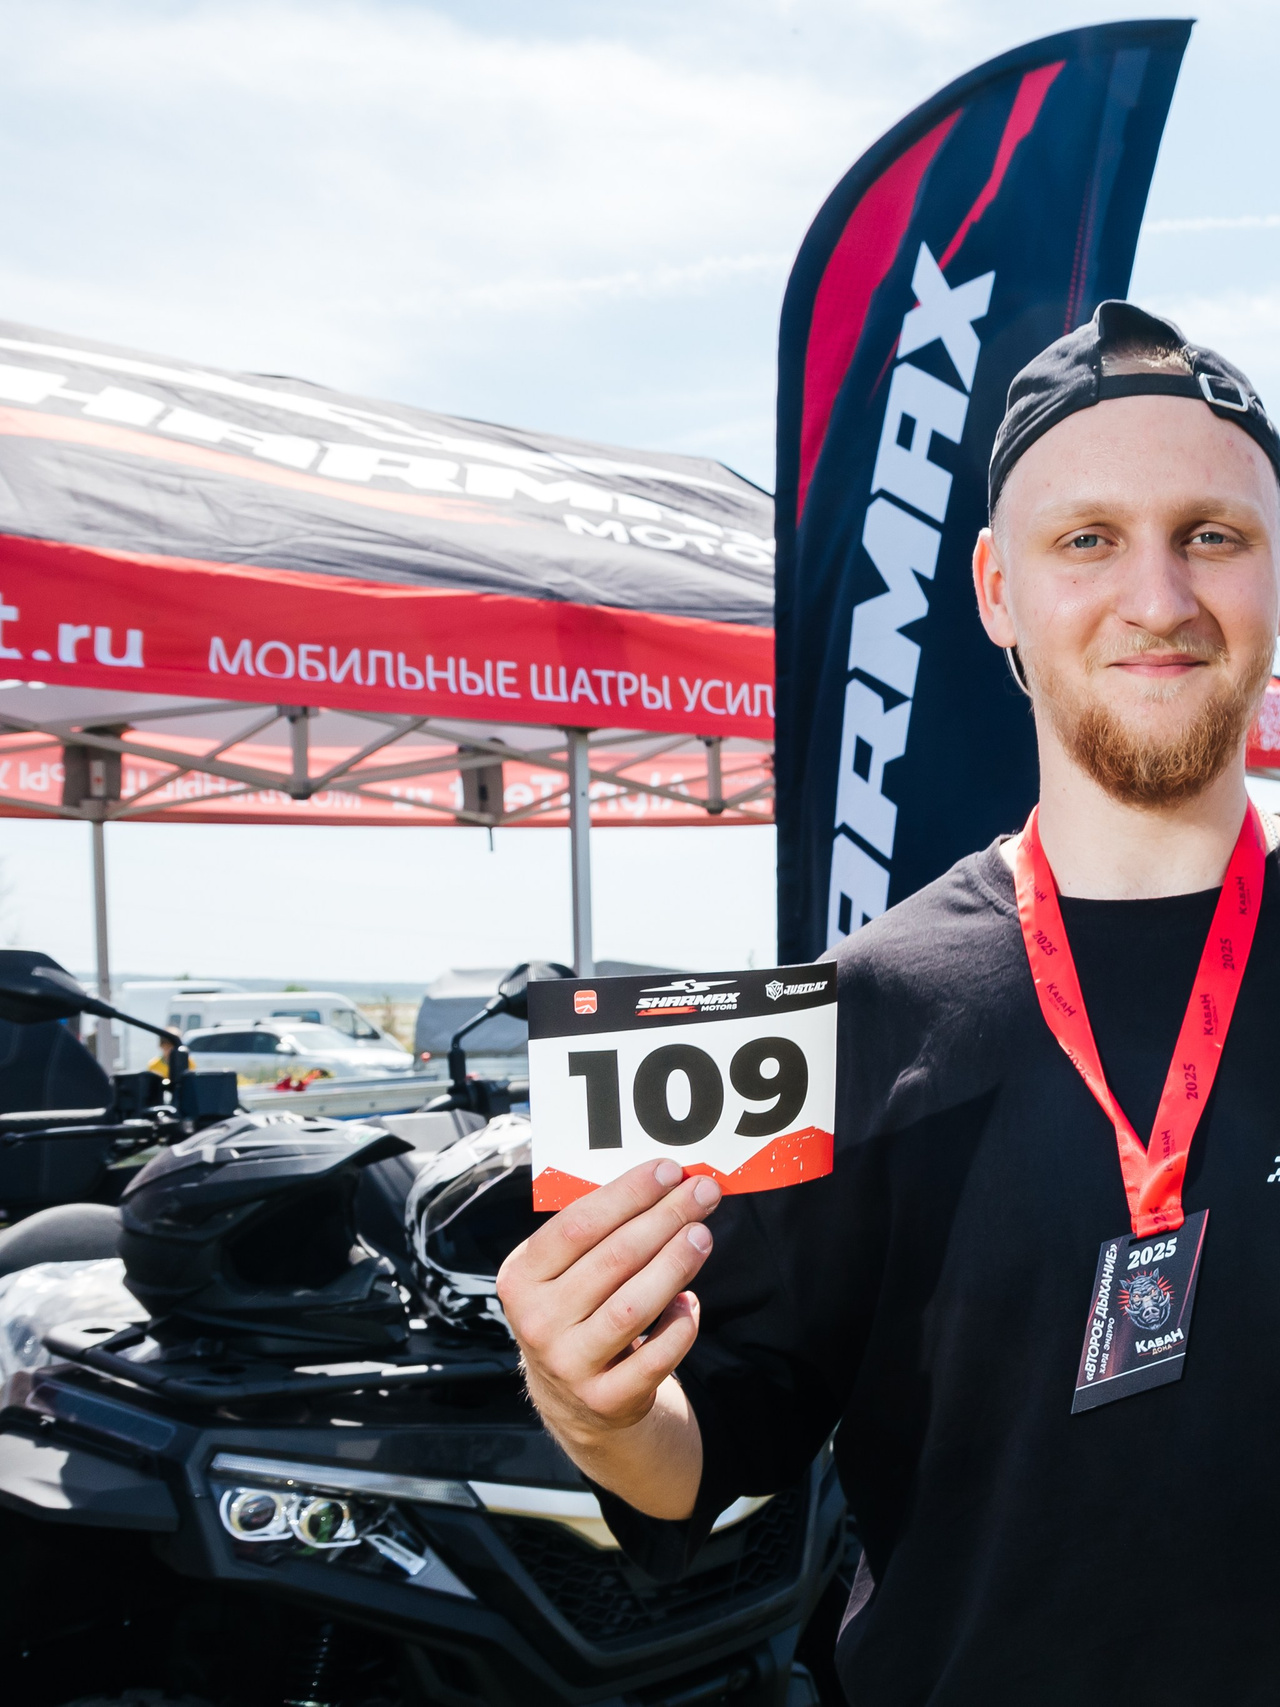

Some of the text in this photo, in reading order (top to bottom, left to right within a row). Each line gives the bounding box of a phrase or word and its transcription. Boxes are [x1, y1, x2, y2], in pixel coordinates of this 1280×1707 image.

[208, 635, 522, 700] МОБИЛЬНЫЕ
[530, 663, 673, 711] ШАТРЫ
[1032, 930, 1058, 956] 2025
[1219, 937, 1235, 971] 2025
[635, 992, 741, 1009] SHARMAX
[701, 1003, 738, 1012] MOTORS
[1046, 982, 1077, 1017] КАБАН
[1200, 993, 1214, 1036] КАБАН
[568, 1036, 809, 1150] 109
[1183, 1063, 1199, 1100] 2025
[1127, 1237, 1178, 1270] 2025
[1085, 1243, 1118, 1382] «ВТОРОЕ ДЫХАНИЕ»
[1099, 1317, 1116, 1374] ХАРД ЭНДУРО
[1152, 1344, 1174, 1356] ДОНА
